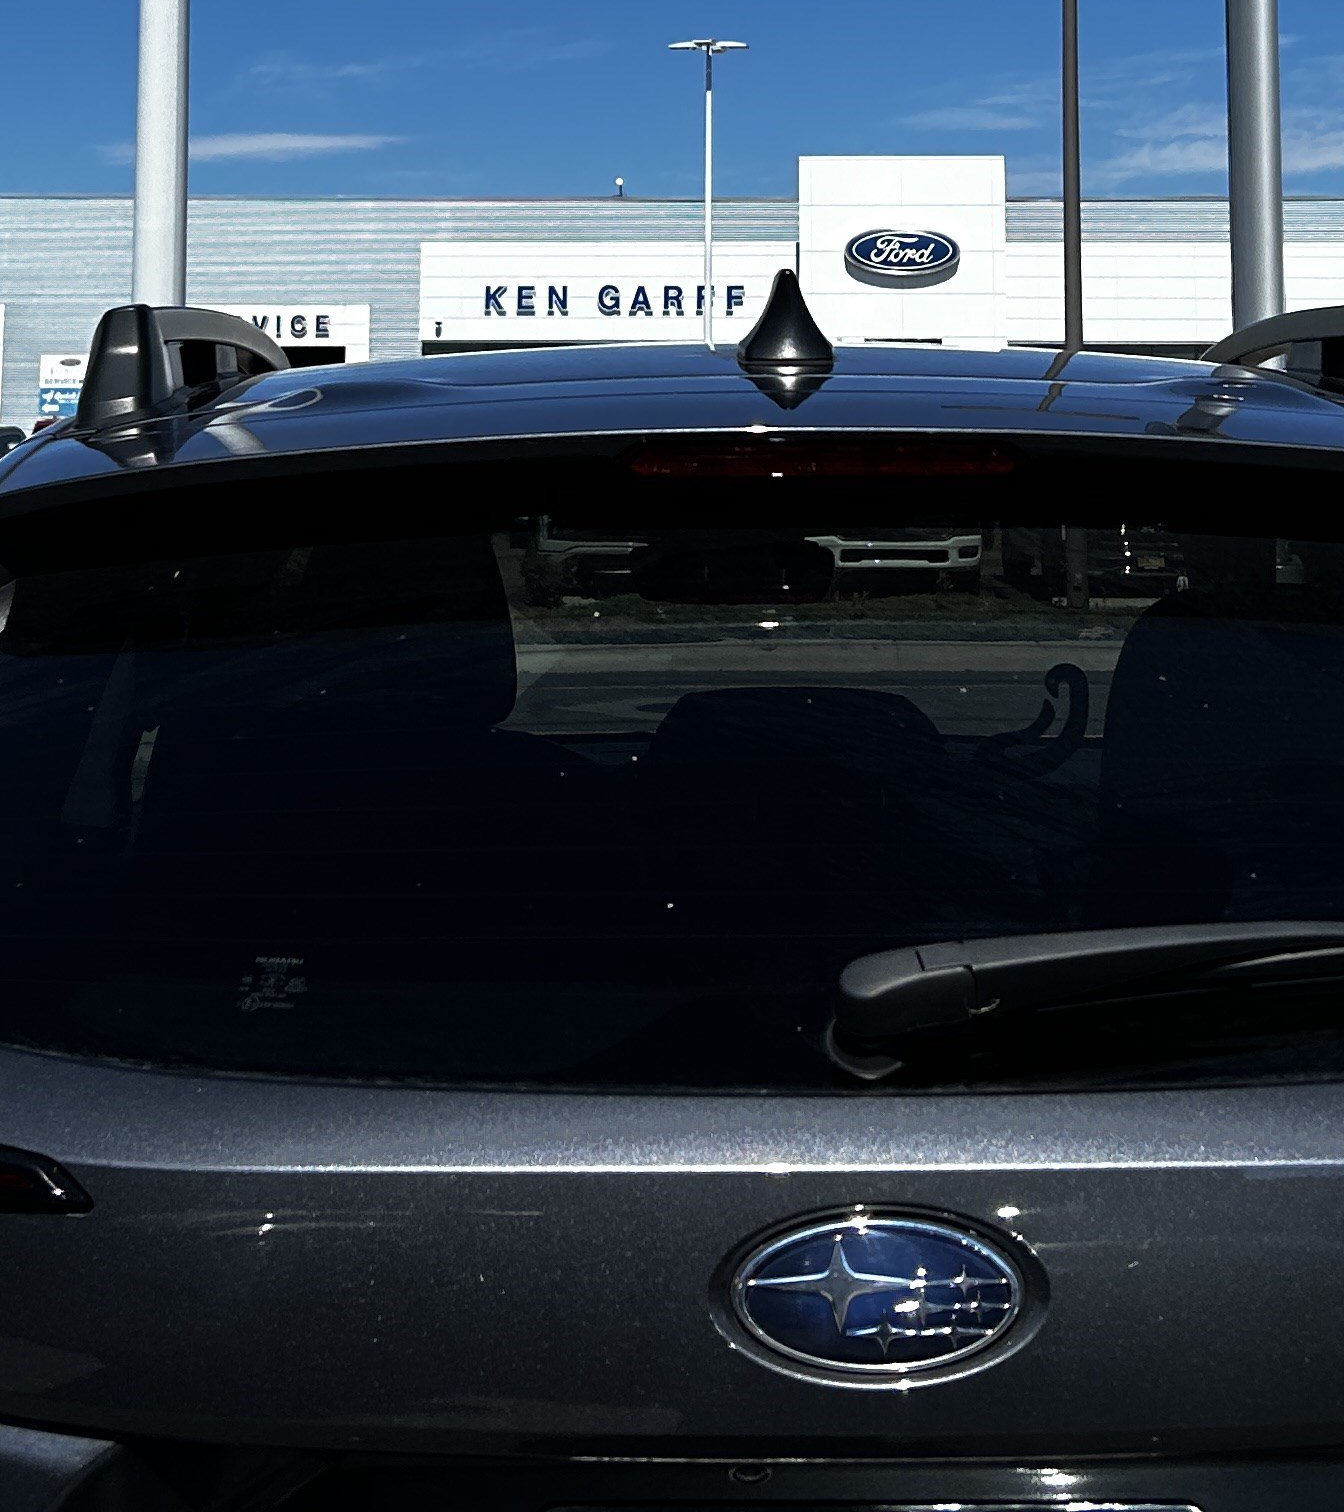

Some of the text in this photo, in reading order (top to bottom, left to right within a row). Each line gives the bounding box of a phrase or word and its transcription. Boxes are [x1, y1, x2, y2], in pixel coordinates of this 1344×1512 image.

[870, 235, 935, 263] Ford
[484, 285, 568, 316] KEN
[252, 315, 330, 338] VICE
